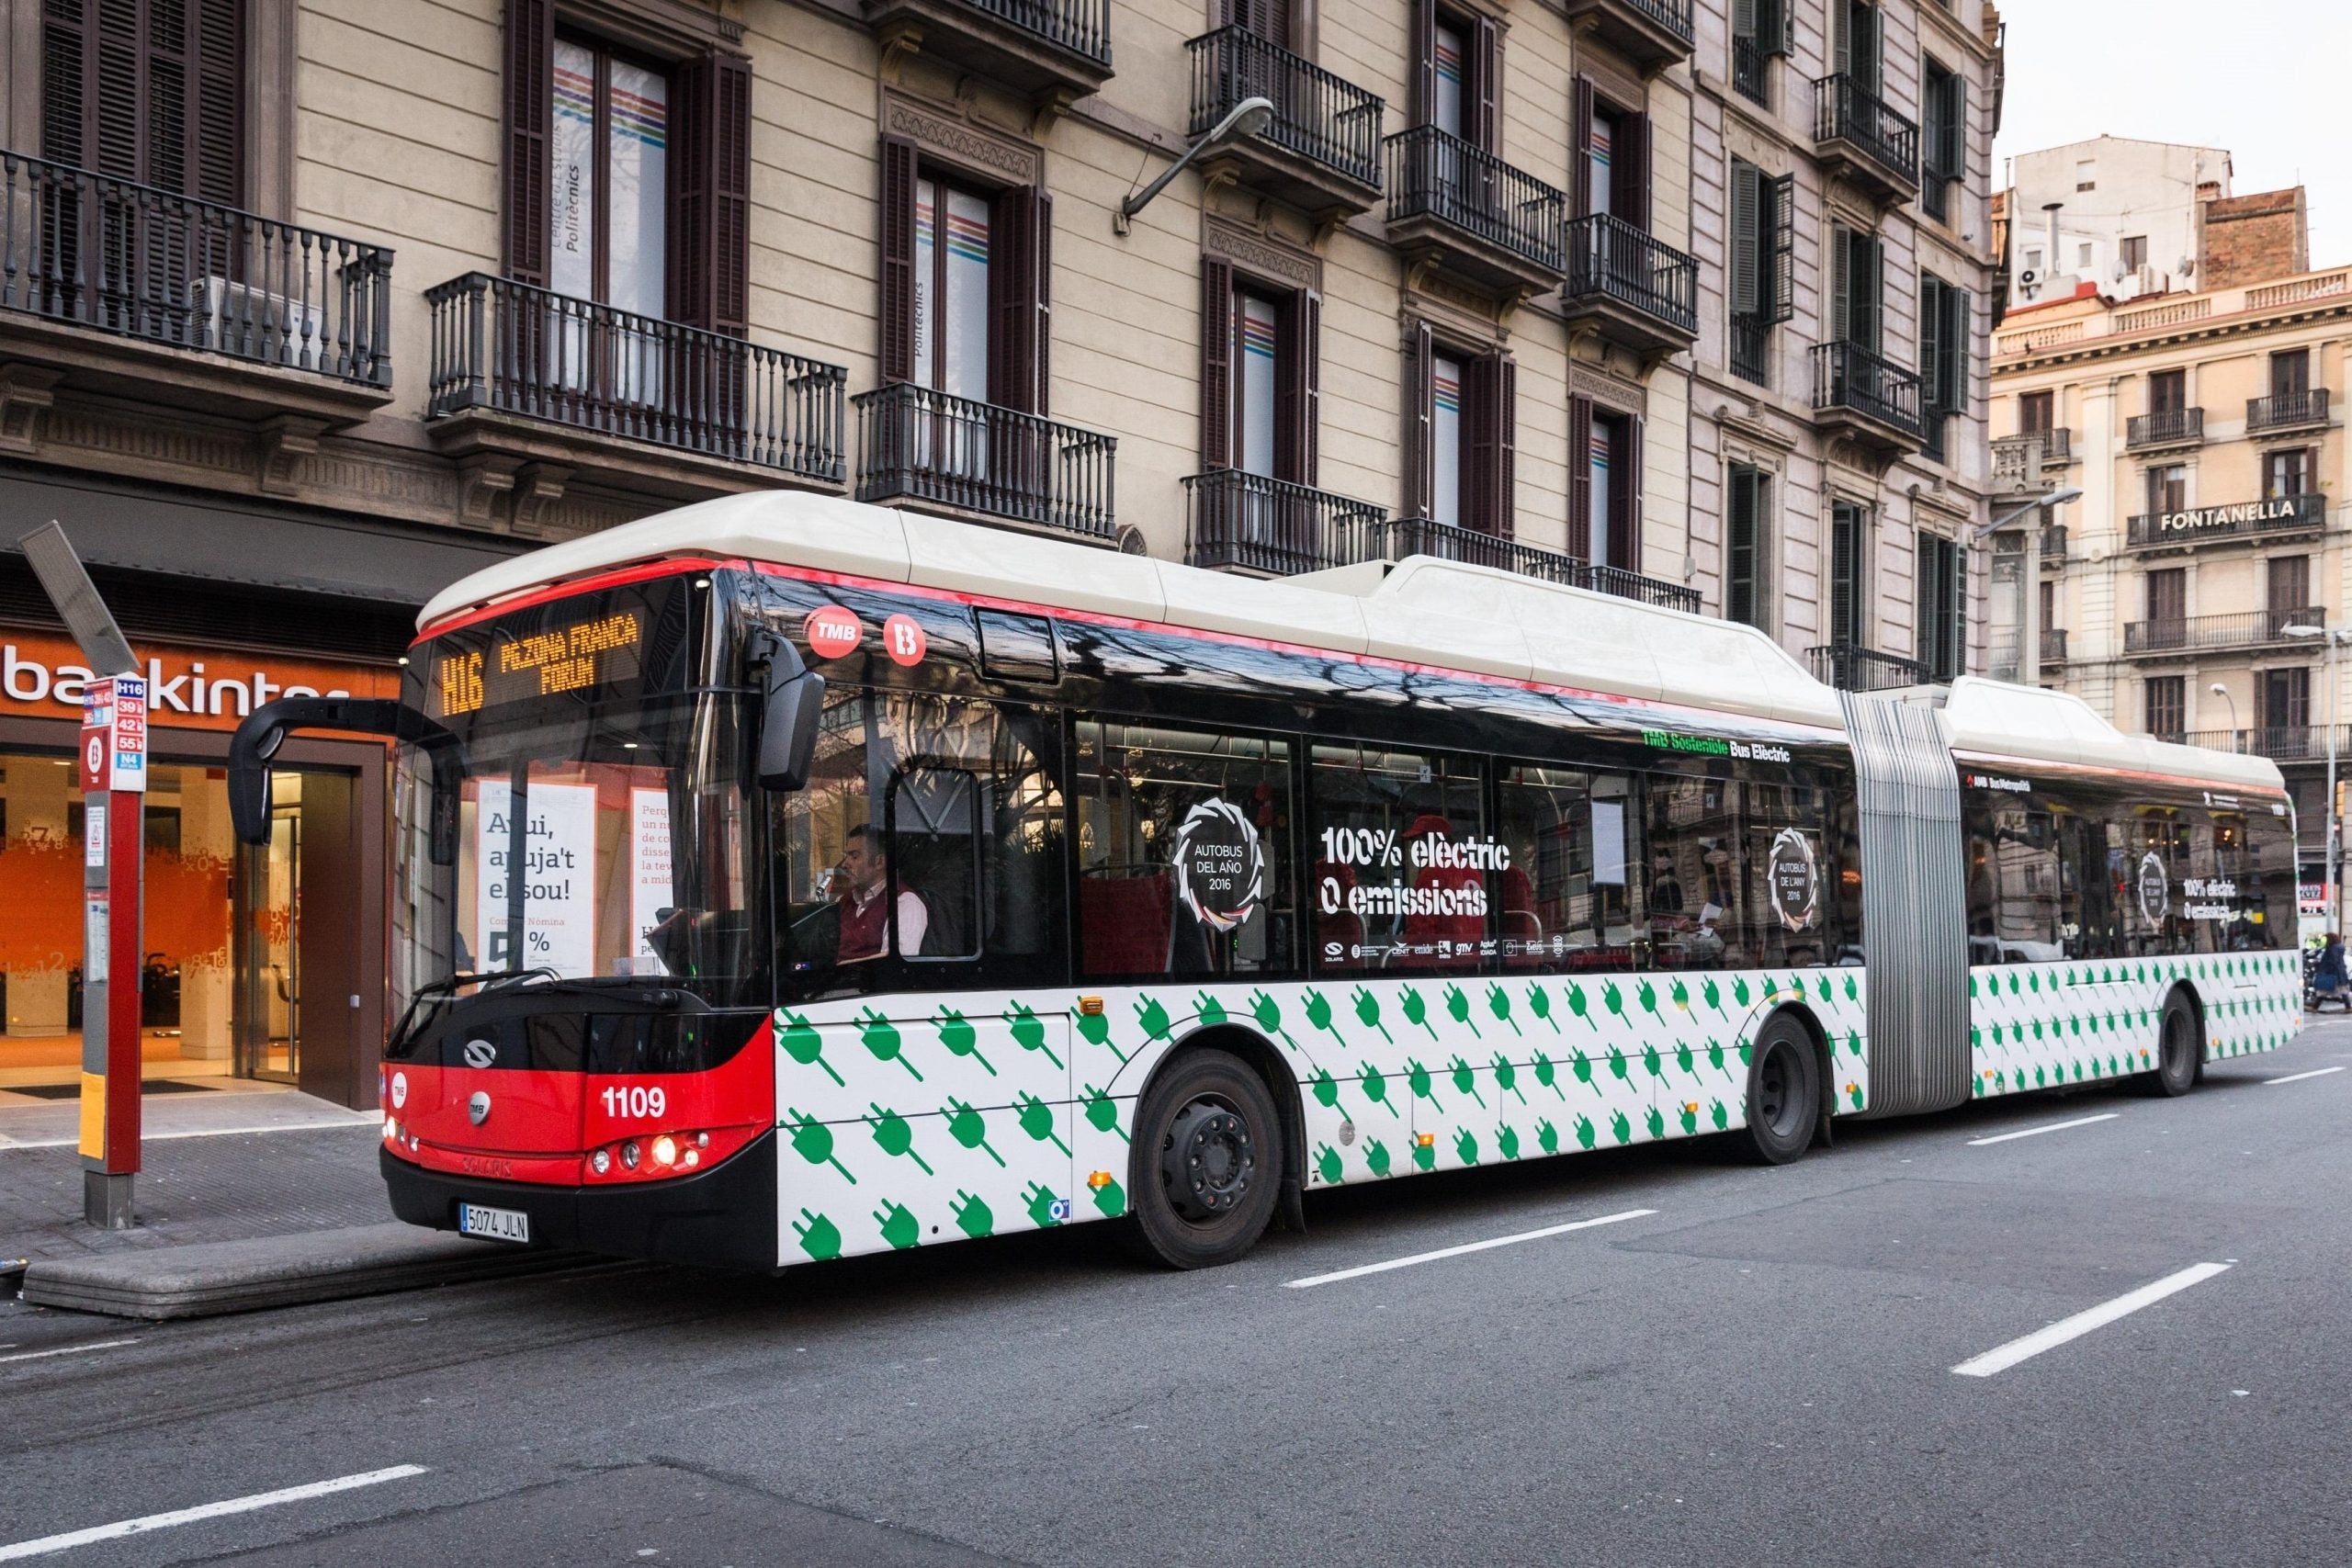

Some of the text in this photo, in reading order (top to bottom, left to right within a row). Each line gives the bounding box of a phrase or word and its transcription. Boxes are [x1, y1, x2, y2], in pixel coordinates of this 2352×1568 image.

[565, 164, 580, 253] Politècnics
[2161, 501, 2295, 531] FONTANELLA
[570, 614, 638, 657] FRANCA
[818, 622, 856, 641] TMB
[894, 624, 917, 656] B
[4, 645, 349, 716] bakint
[442, 651, 484, 716] H16
[541, 656, 594, 694] FORUM
[118, 682, 143, 695] H16
[119, 701, 136, 713] 39
[119, 719, 136, 731] 42
[119, 737, 136, 750] 55
[1729, 740, 1750, 759] Bus
[1751, 743, 1791, 763] Elèctric
[120, 754, 137, 763] N4
[641, 805, 669, 818] Perq
[487, 813, 554, 840] Aui,
[642, 832, 655, 842] de
[641, 846, 670, 856] disse
[1194, 844, 1242, 857] AUTOBUS
[1321, 827, 1510, 872] 100% elèctric
[641, 860, 651, 870] la
[1196, 860, 1242, 874] DEL AÑO
[523, 879, 570, 900] sou!
[1209, 878, 1231, 890] 2016
[2184, 879, 2206, 897] 100%
[1321, 876, 1487, 916] 0 emissions
[1787, 891, 1801, 900] 2016
[527, 915, 565, 927] Nòmina
[602, 1086, 666, 1118] 1109
[469, 1209, 526, 1239] 5074 JLN
